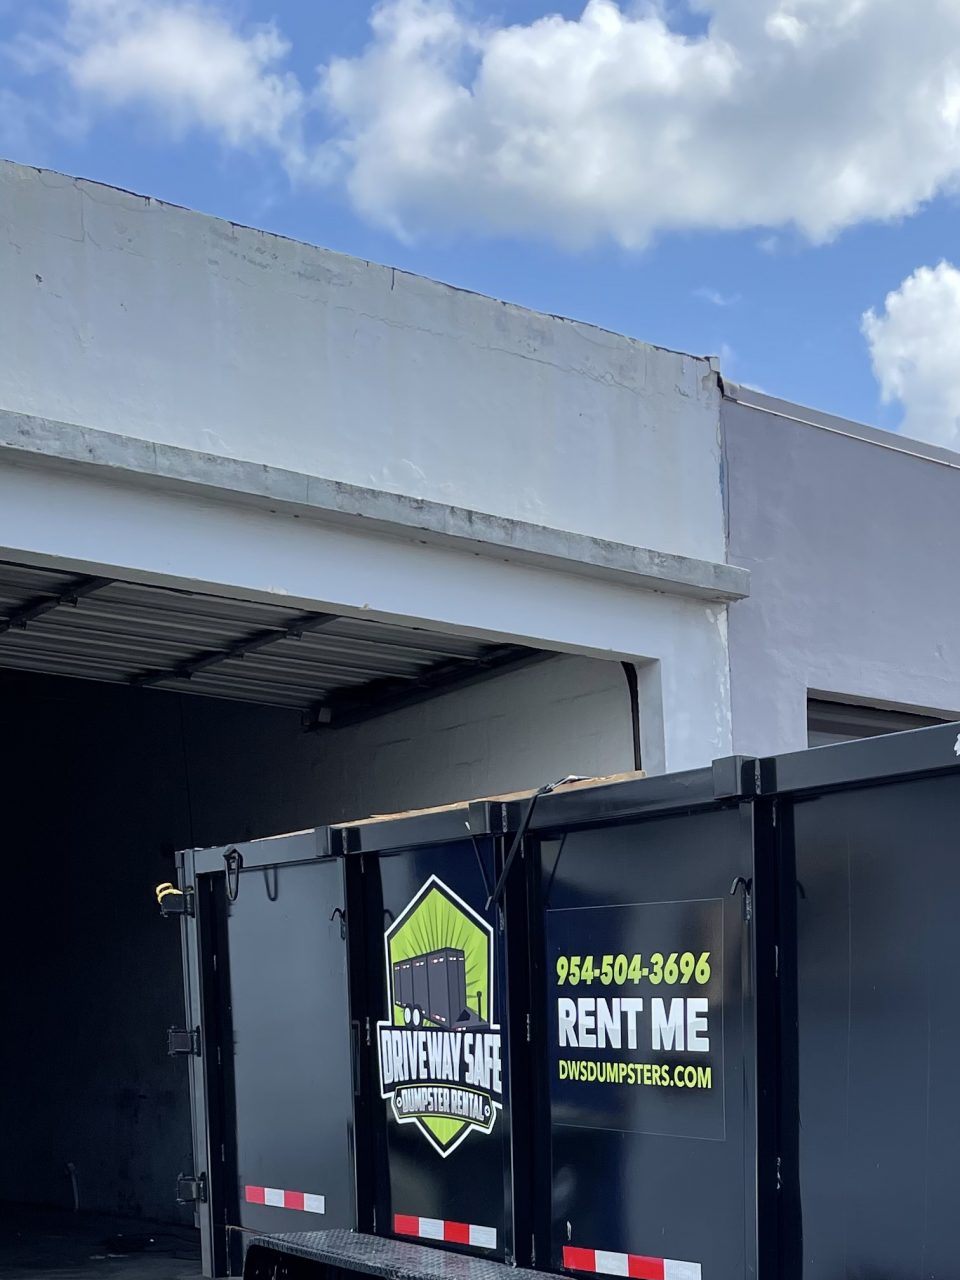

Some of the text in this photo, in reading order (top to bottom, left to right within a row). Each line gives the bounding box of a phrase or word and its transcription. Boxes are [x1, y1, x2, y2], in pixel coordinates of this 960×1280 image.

[556, 952, 711, 985] 954-504-3696
[557, 998, 710, 1052] RENT ME
[381, 1029, 503, 1094] DRIVEWAY SAFE
[558, 1060, 712, 1089] DWSDUMPSTERS.COM
[401, 1087, 485, 1121] DUMPSTER RENTAL
